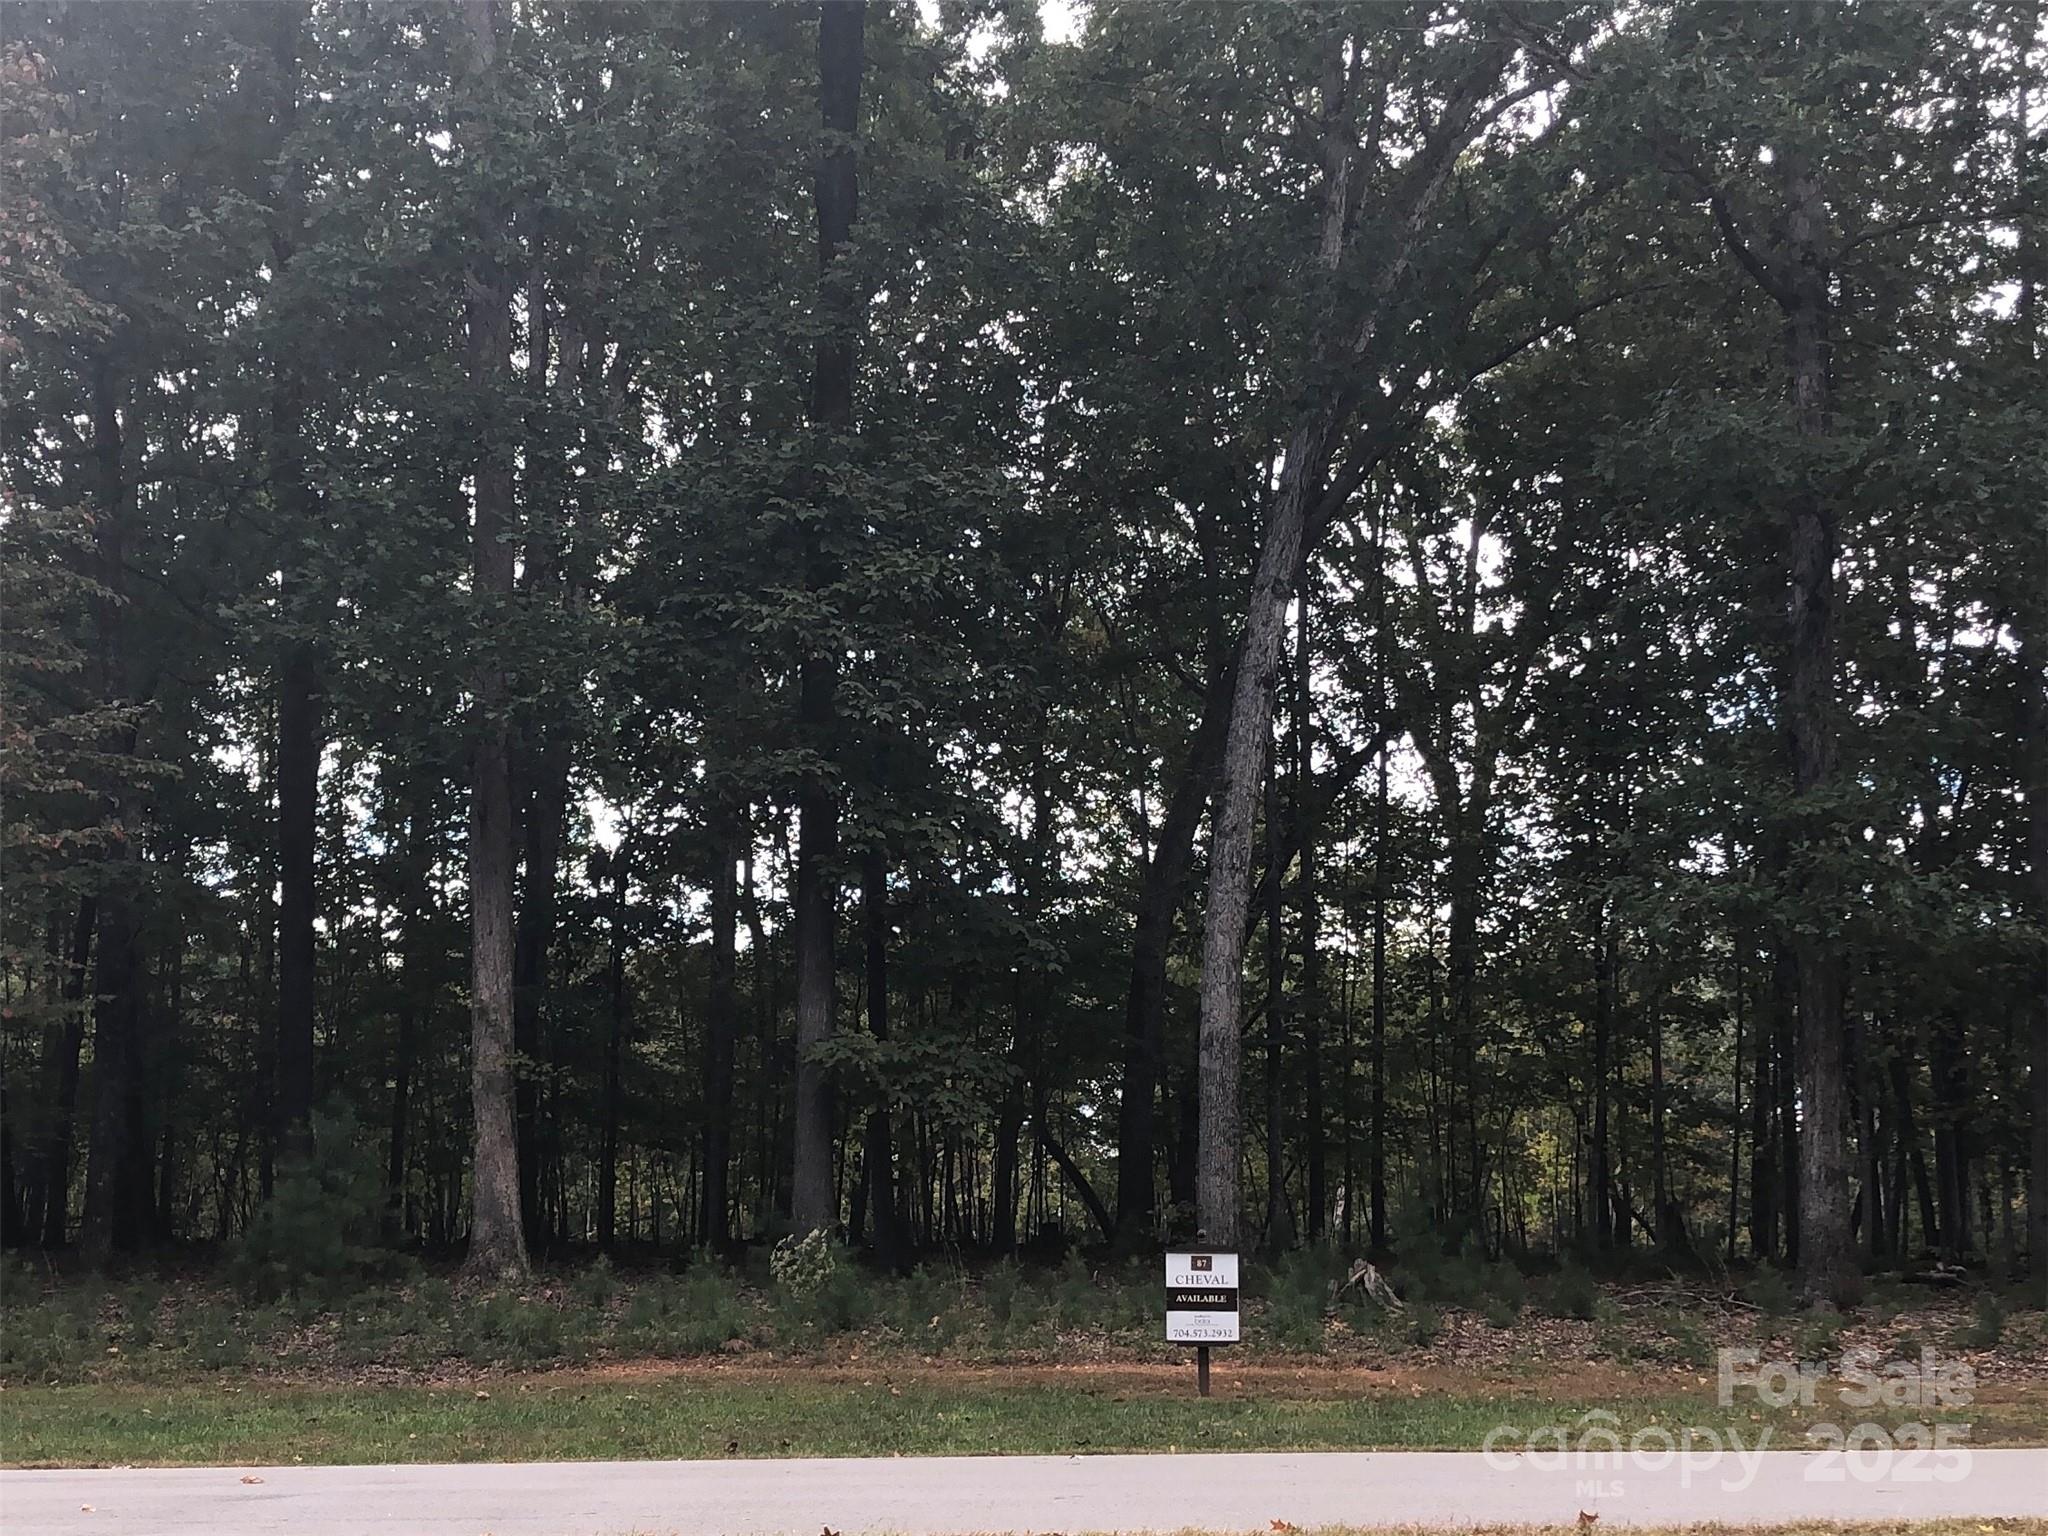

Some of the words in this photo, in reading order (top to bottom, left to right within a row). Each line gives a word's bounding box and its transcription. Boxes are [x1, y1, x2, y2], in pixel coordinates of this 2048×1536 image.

[1175, 1275, 1229, 1285] CHEVAL
[1175, 1295, 1227, 1303] AVAILABLE
[1173, 1329, 1233, 1338] 704.573.2932
